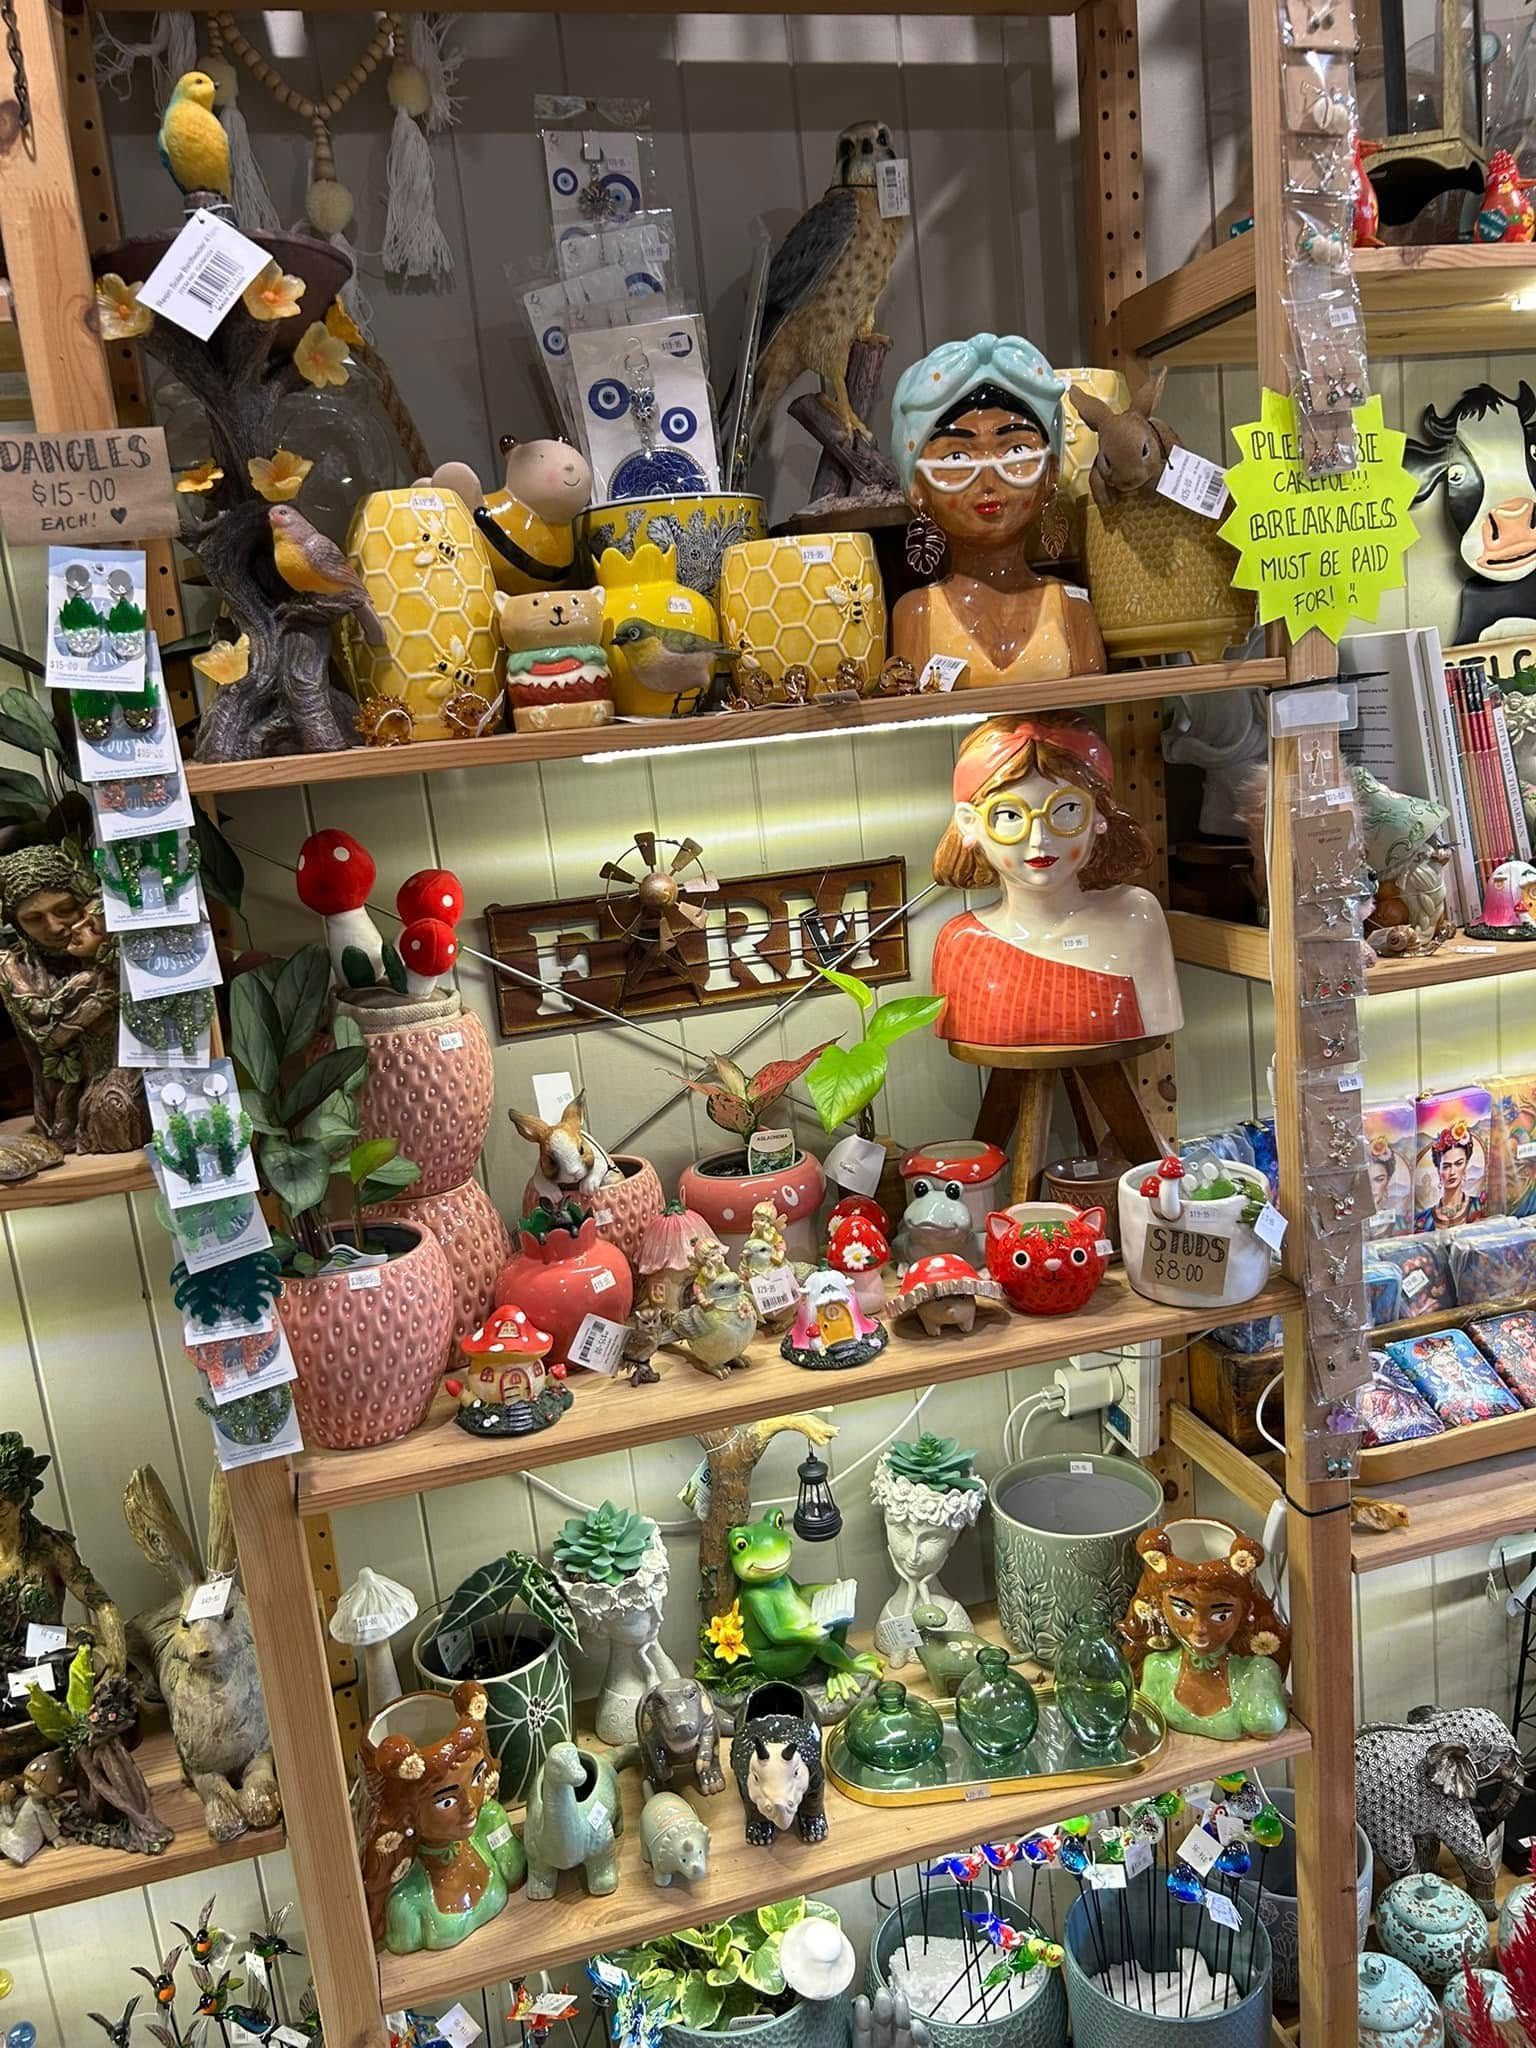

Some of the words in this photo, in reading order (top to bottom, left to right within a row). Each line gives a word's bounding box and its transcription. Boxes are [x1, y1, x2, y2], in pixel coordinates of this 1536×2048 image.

[0, 434, 152, 474] DANGLES
[32, 477, 116, 507] $15-00
[41, 512, 97, 532] EACH!
[1249, 497, 1397, 541] BREAKAGES
[1261, 552, 1311, 582] MUST
[1319, 549, 1341, 577] BE
[1352, 544, 1389, 574] PAID
[1294, 585, 1336, 616] FOR!
[1495, 717, 1507, 745] GIFTS
[1502, 747, 1513, 775] FROM
[1508, 777, 1517, 797] THE
[1512, 799, 1526, 839] GARDEN
[527, 878, 881, 1016] FRM
[1150, 1227, 1226, 1263] STUDS
[1154, 1253, 1204, 1282] $8-00
